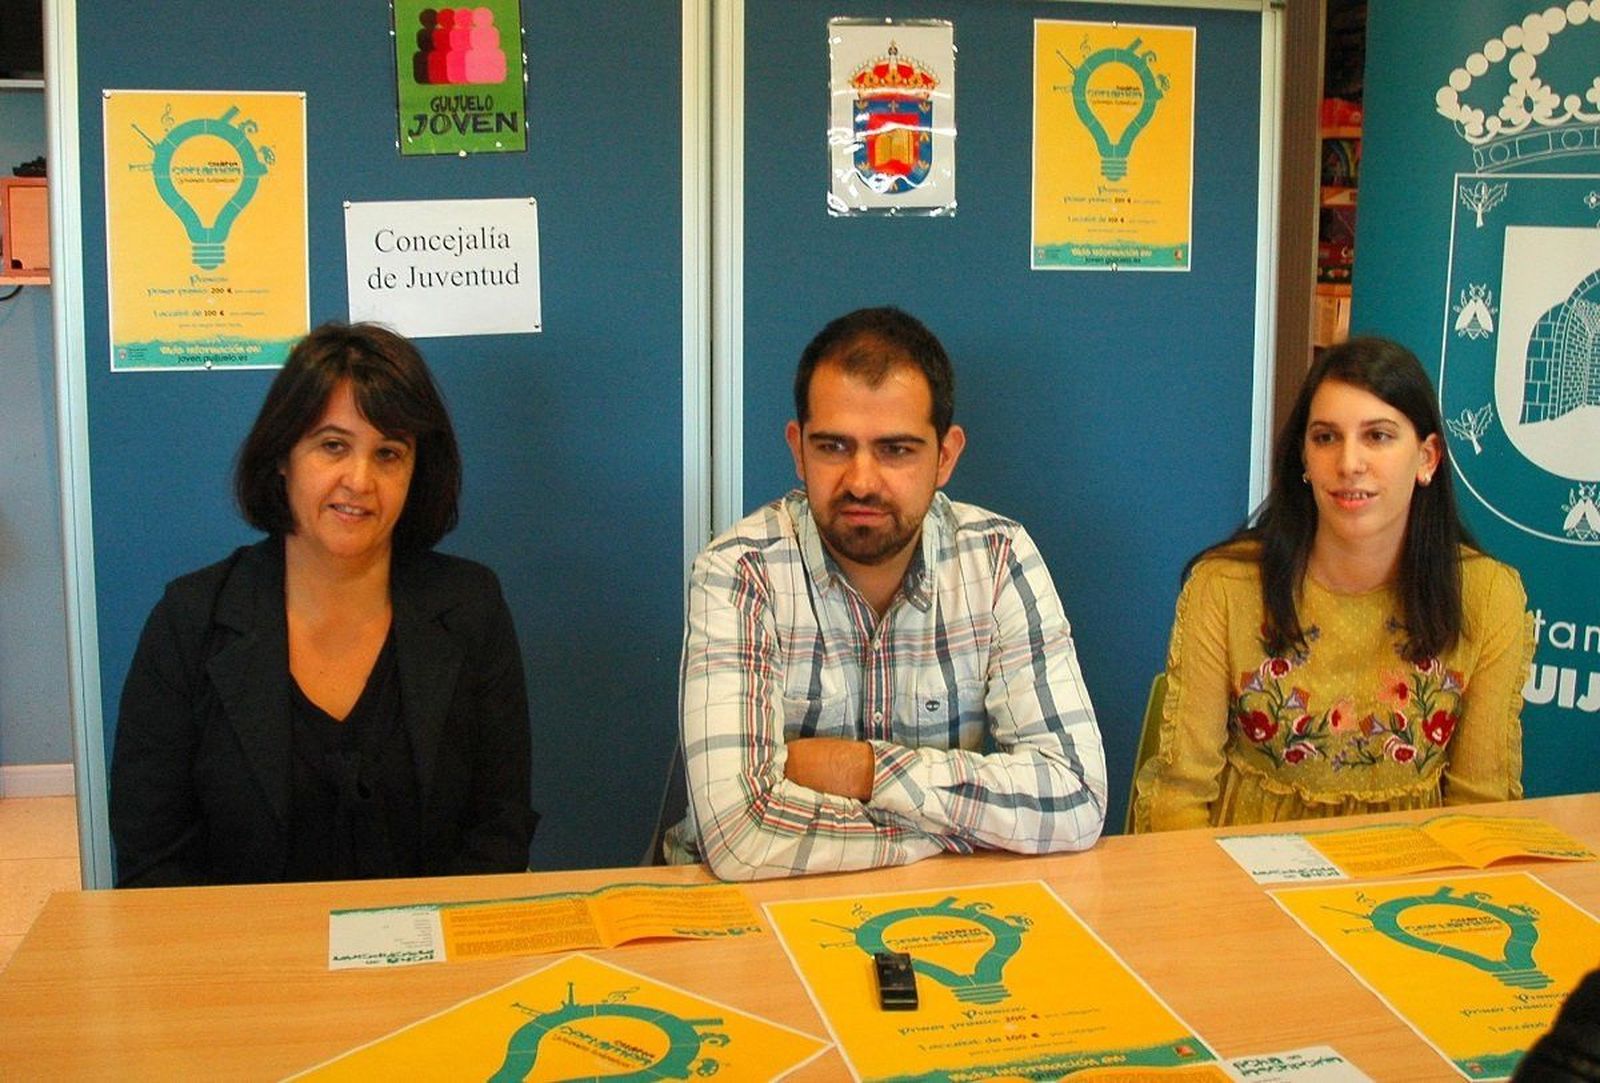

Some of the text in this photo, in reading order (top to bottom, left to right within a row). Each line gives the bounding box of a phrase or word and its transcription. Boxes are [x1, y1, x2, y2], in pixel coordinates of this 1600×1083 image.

[430, 95, 494, 113] GUIJUELO
[408, 111, 518, 137] JOVEN
[374, 226, 511, 257] Concejalía
[367, 262, 520, 290] de Juventud
